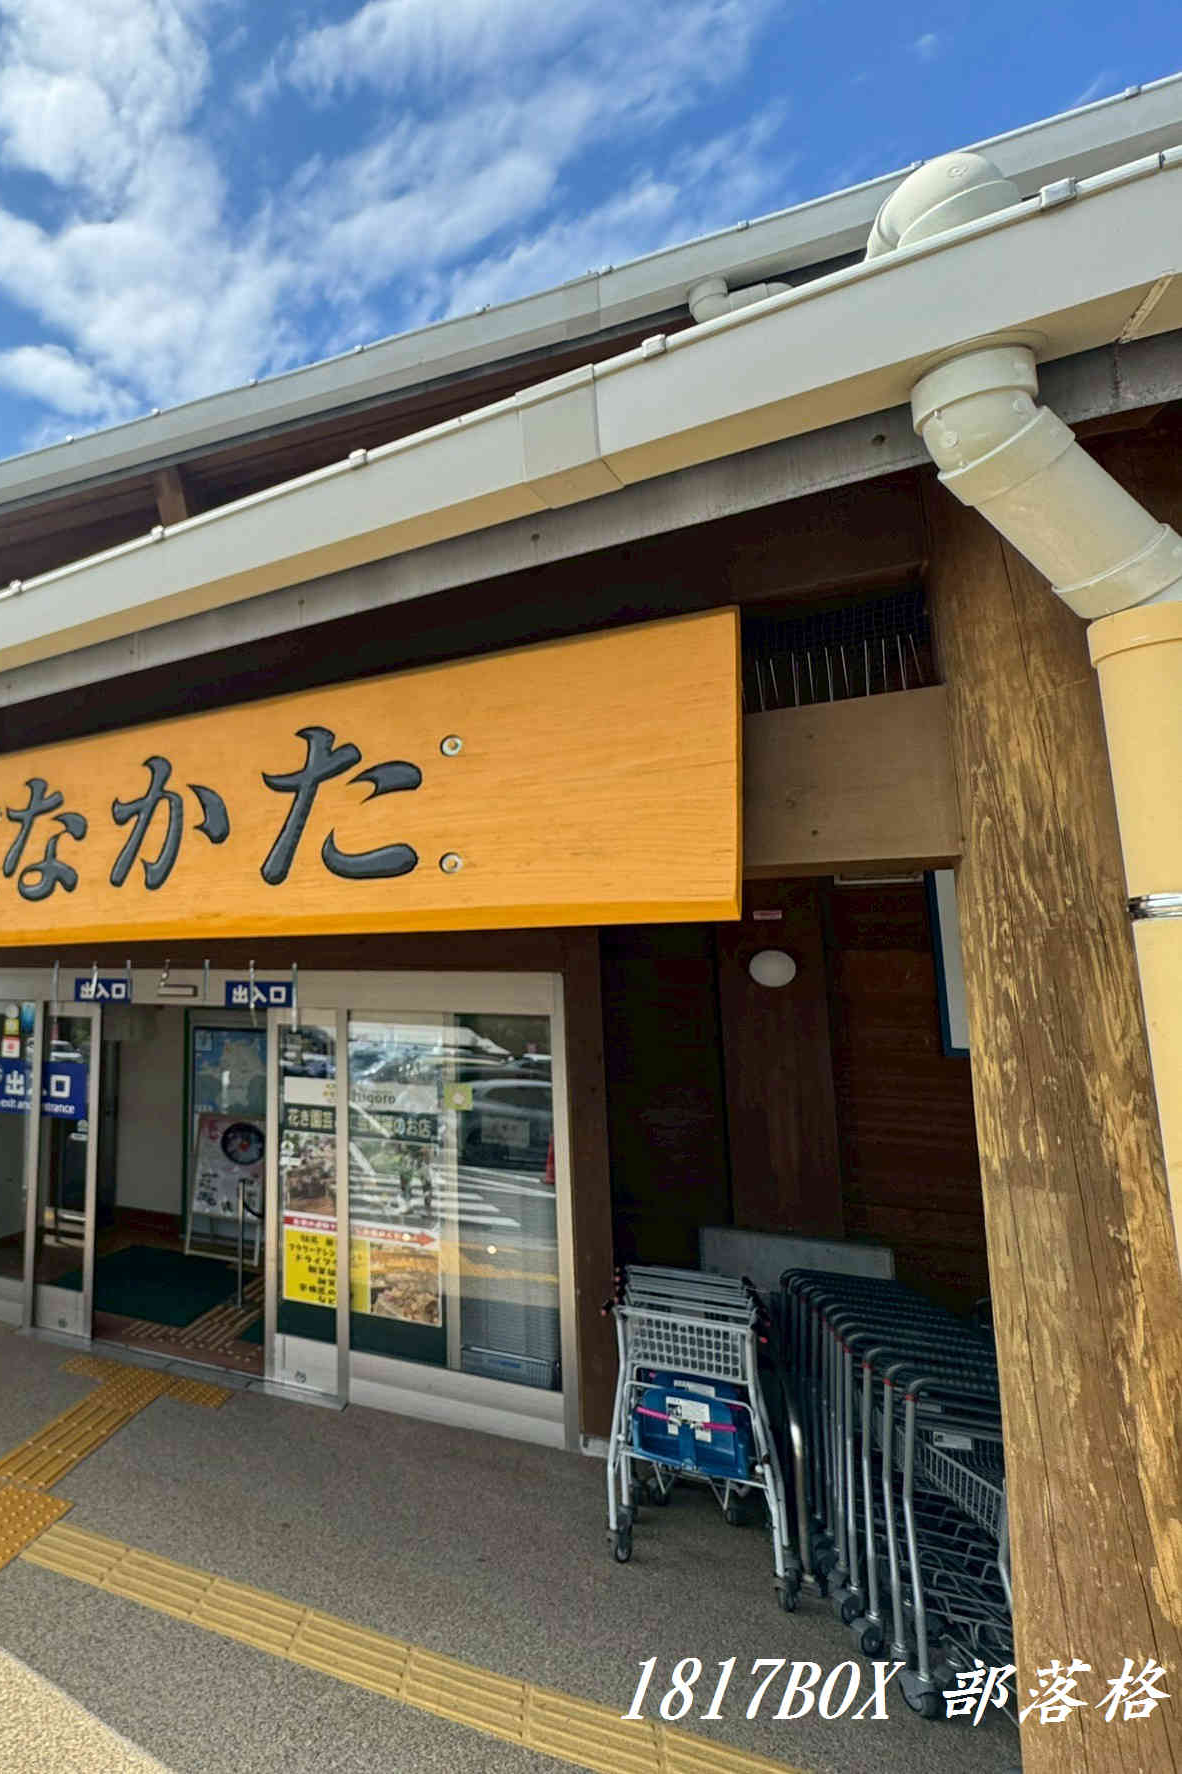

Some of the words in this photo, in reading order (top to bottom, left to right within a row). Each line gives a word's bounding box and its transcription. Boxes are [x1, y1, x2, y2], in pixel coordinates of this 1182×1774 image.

[79, 981, 127, 999] 出入口
[231, 984, 287, 1004] 出入口
